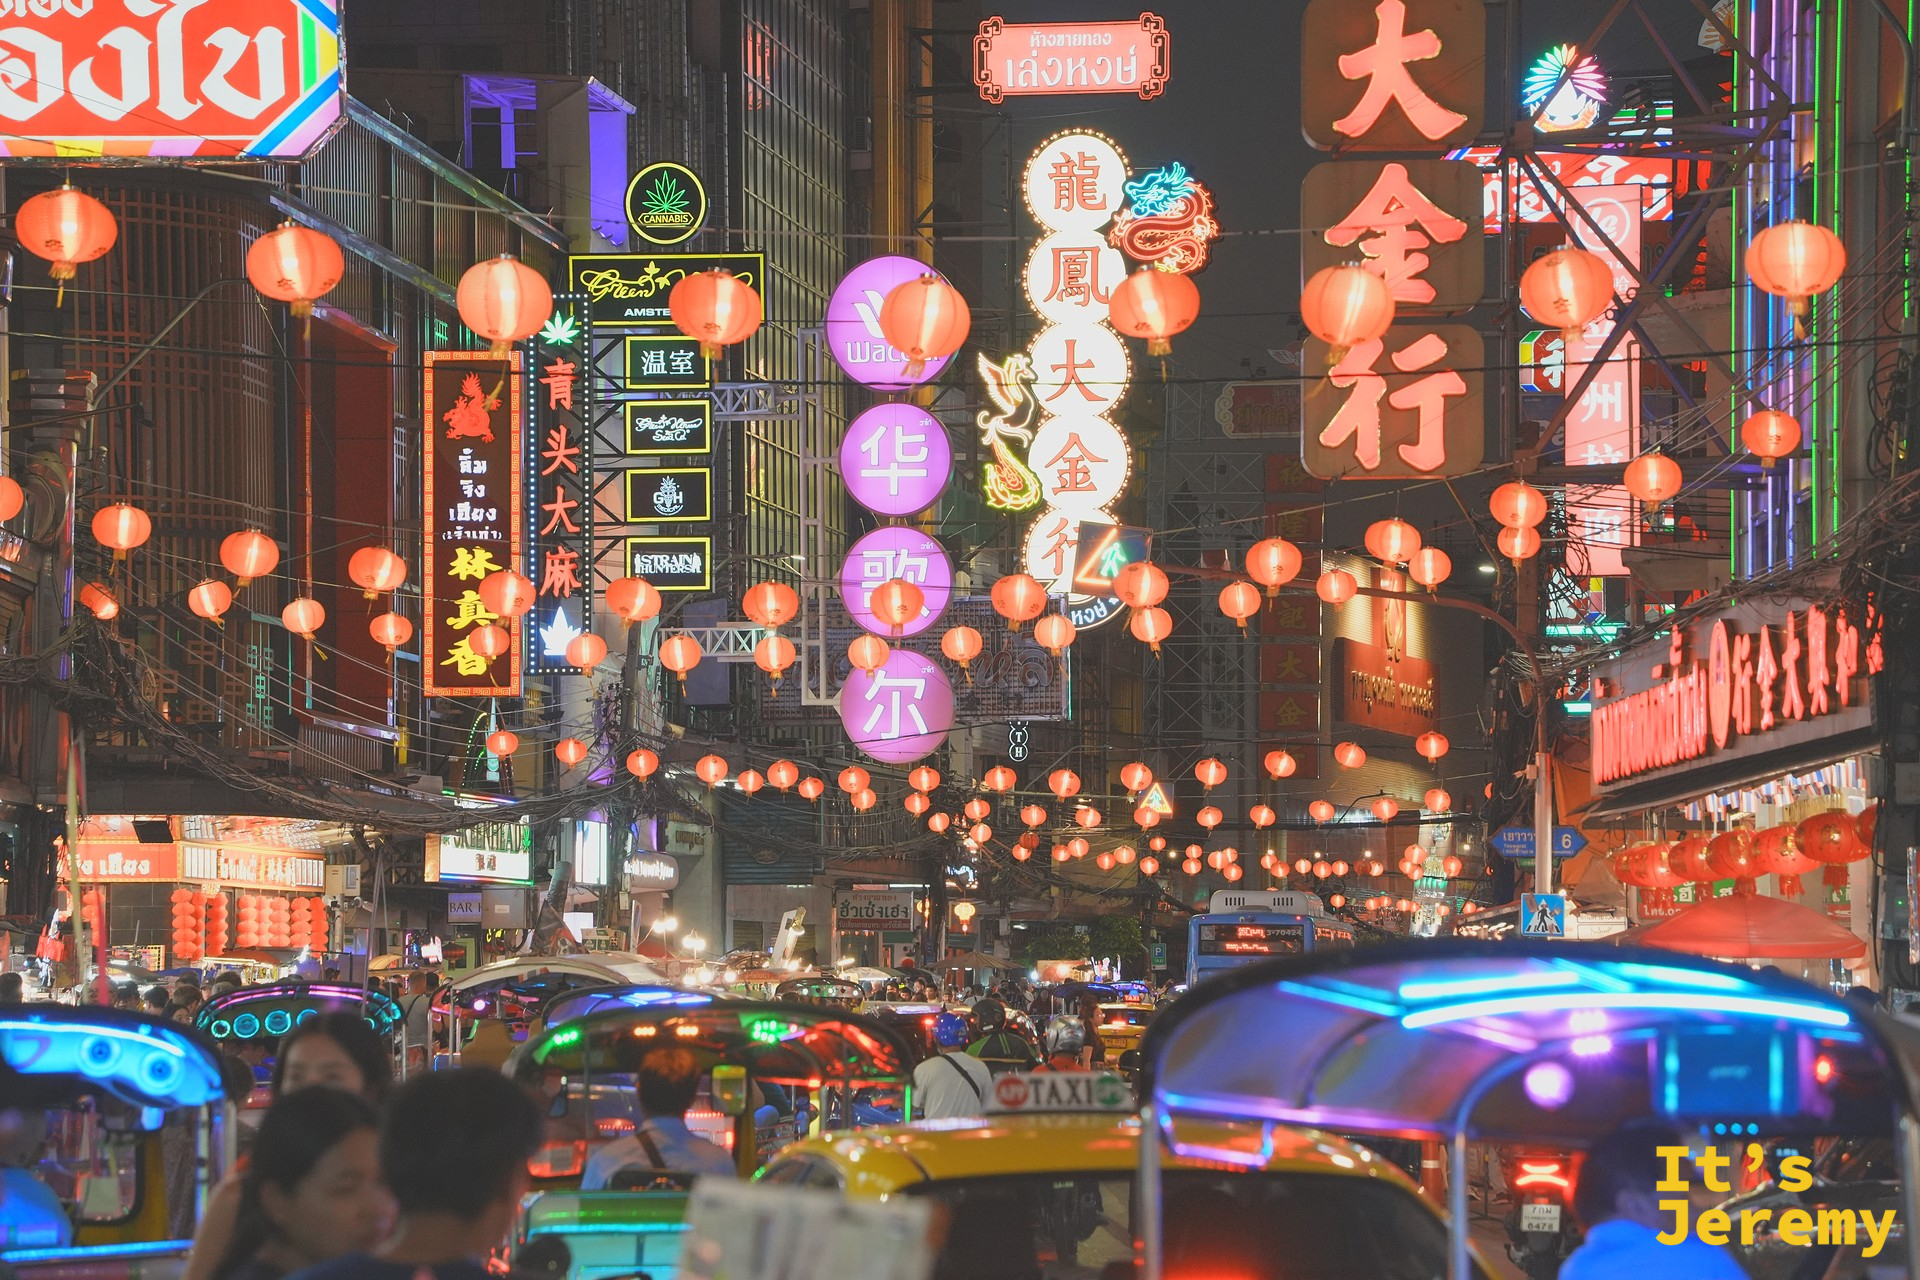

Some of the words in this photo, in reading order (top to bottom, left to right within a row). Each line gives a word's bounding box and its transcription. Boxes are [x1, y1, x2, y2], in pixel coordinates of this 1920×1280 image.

[1029, 31, 1113, 48] ห้างขายทอง
[1006, 44, 1138, 88] เล่งหงษ์
[643, 214, 689, 224] CANNABIS
[1319, 0, 1467, 472] 大金行
[580, 268, 656, 303] Green
[624, 308, 671, 317] AMSTE
[640, 349, 695, 376] 温室
[539, 356, 583, 599] 青头大麻
[641, 553, 694, 566] STRAIN
[1562, 833, 1572, 849] 6
[449, 902, 472, 913] BAR
[1155, 947, 1162, 956] P
[1029, 1077, 1094, 1106] TAXI
